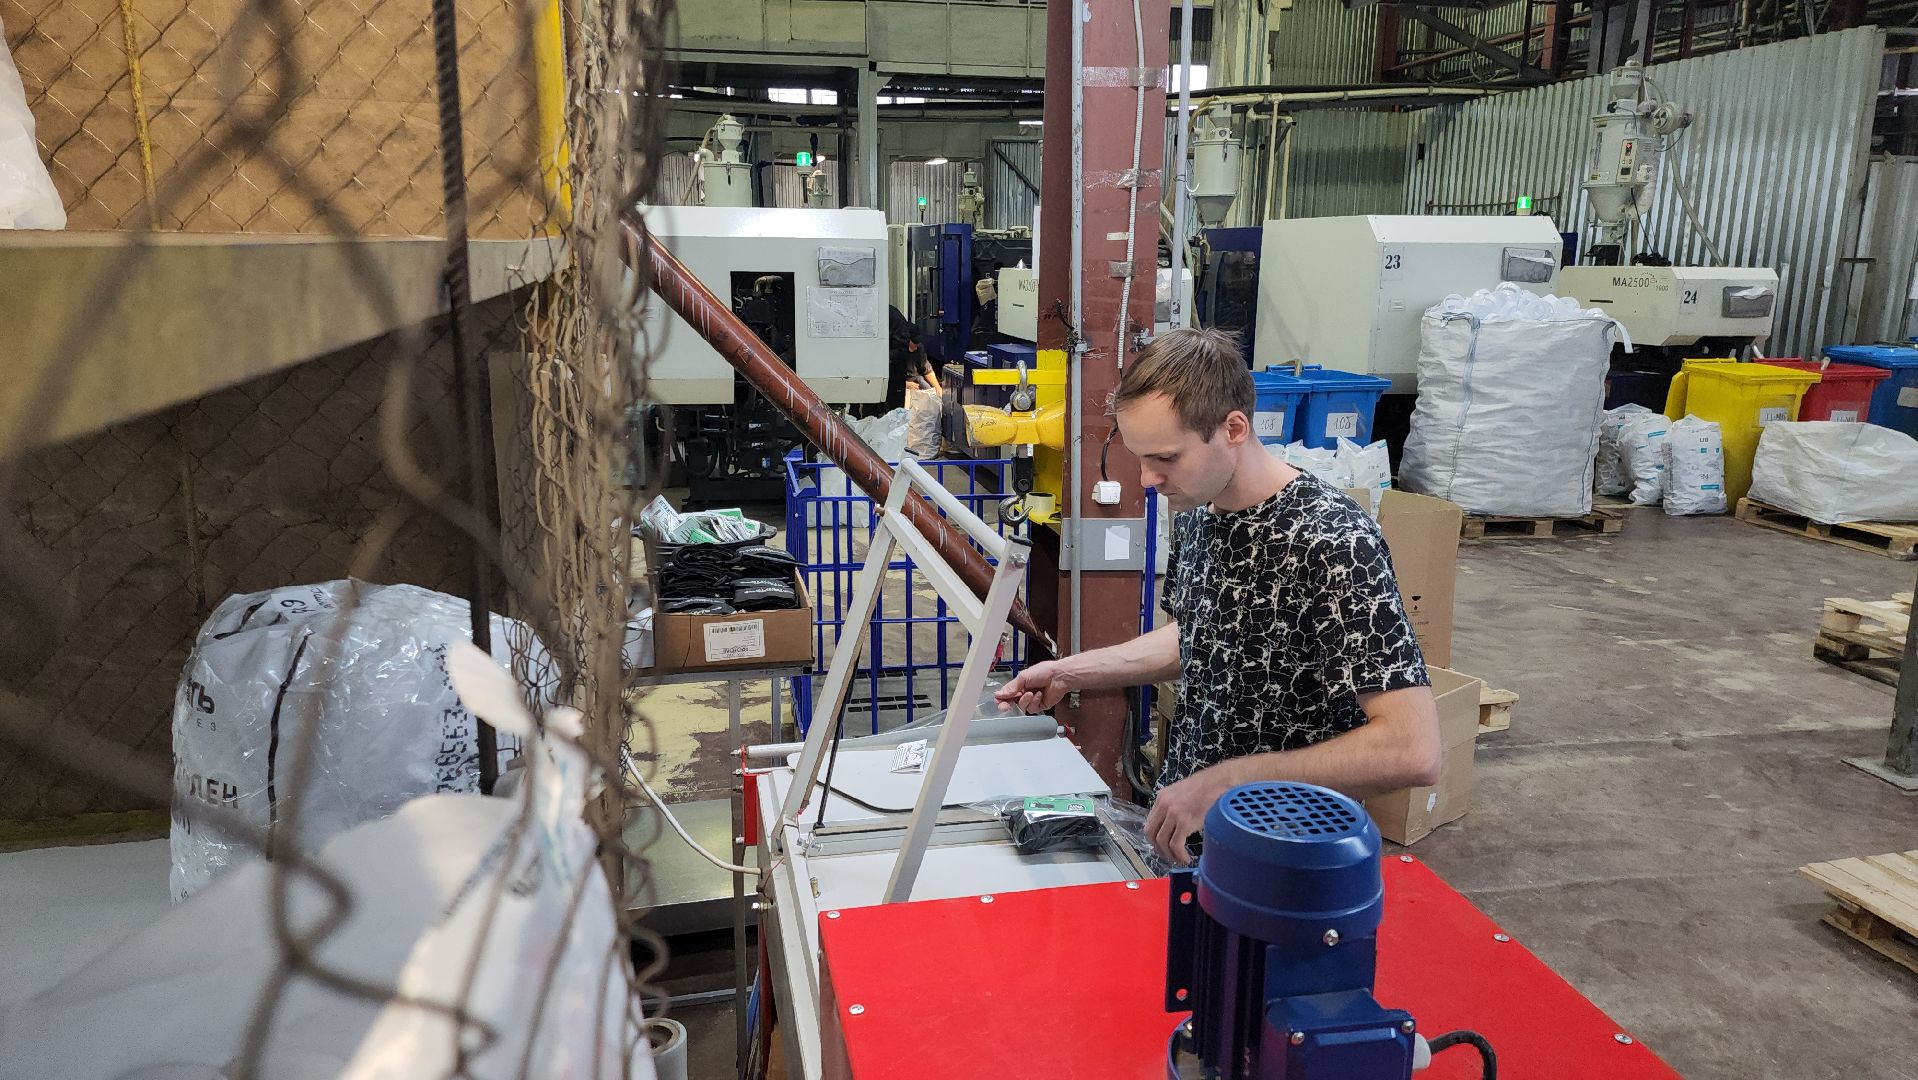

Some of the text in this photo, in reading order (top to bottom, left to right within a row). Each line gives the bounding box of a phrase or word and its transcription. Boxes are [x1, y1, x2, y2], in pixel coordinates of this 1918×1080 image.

[1384, 254, 1401, 270] 23
[1612, 276, 1650, 288] MA2500
[1683, 289, 1698, 305] 24
